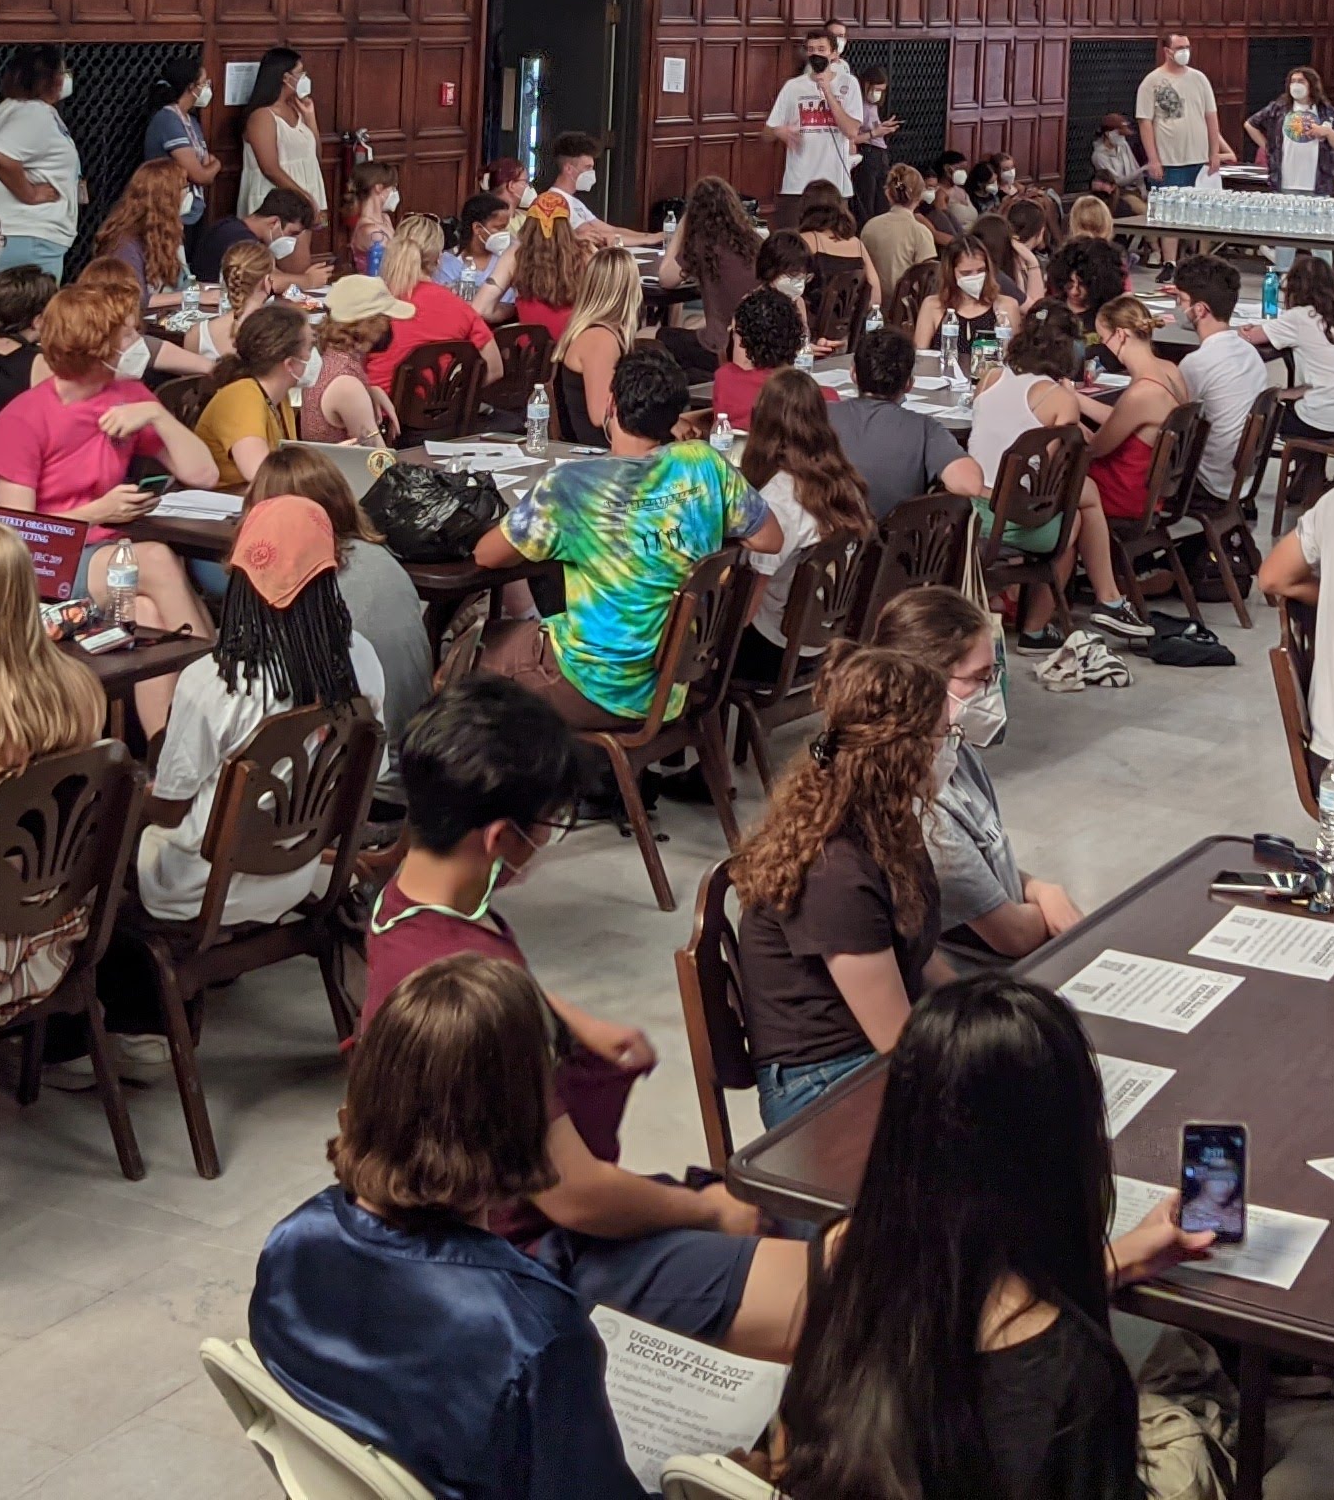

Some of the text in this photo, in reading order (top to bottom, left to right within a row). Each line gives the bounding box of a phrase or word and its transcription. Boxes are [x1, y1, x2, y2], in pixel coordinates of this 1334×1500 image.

[25, 520, 75, 536] ORGANIZING
[626, 1342, 692, 1373] KICKOFF
[691, 1368, 742, 1392] EVENT
[629, 1330, 754, 1380] UGSDW FALL 2022
